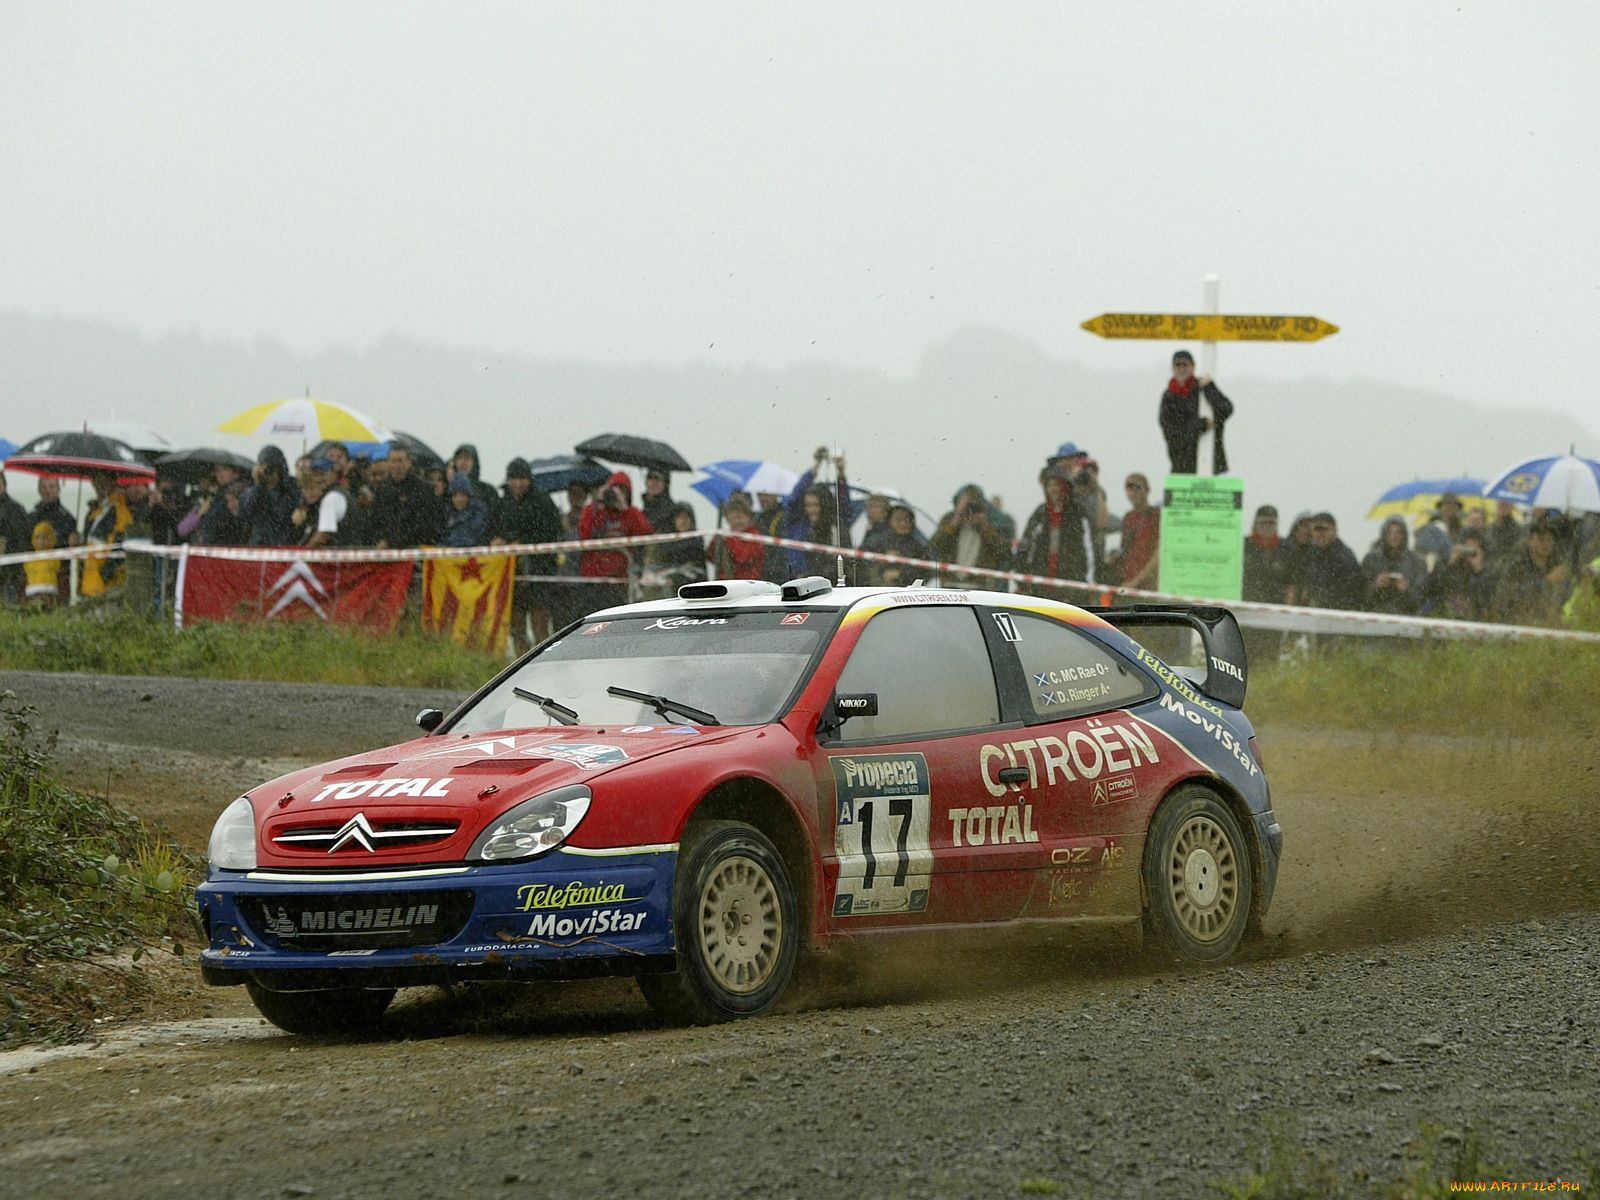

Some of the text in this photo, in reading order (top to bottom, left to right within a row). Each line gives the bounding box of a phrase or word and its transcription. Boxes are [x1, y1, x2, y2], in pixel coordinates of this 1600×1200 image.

[1102, 315, 1198, 331] SWAMP RD
[1222, 317, 1319, 333] SWAMP RD
[643, 616, 729, 631] Xsara
[995, 614, 1017, 641] 17
[1076, 666, 1097, 678] Rae
[1095, 663, 1109, 676] O+
[1210, 656, 1245, 683] TOTAL
[838, 698, 868, 708] NIKKO
[1056, 691, 1070, 704] D.
[1068, 687, 1100, 702] Ringer
[1159, 692, 1258, 777] MoviStar
[979, 718, 1160, 798] CITROËN
[839, 758, 919, 790] Propecia
[310, 777, 455, 803] TOTAL
[839, 801, 852, 823] A
[948, 804, 1040, 847] TOTAL
[857, 798, 914, 890] 17
[300, 904, 440, 930] MICHELIN
[527, 909, 648, 937] MoviStar
